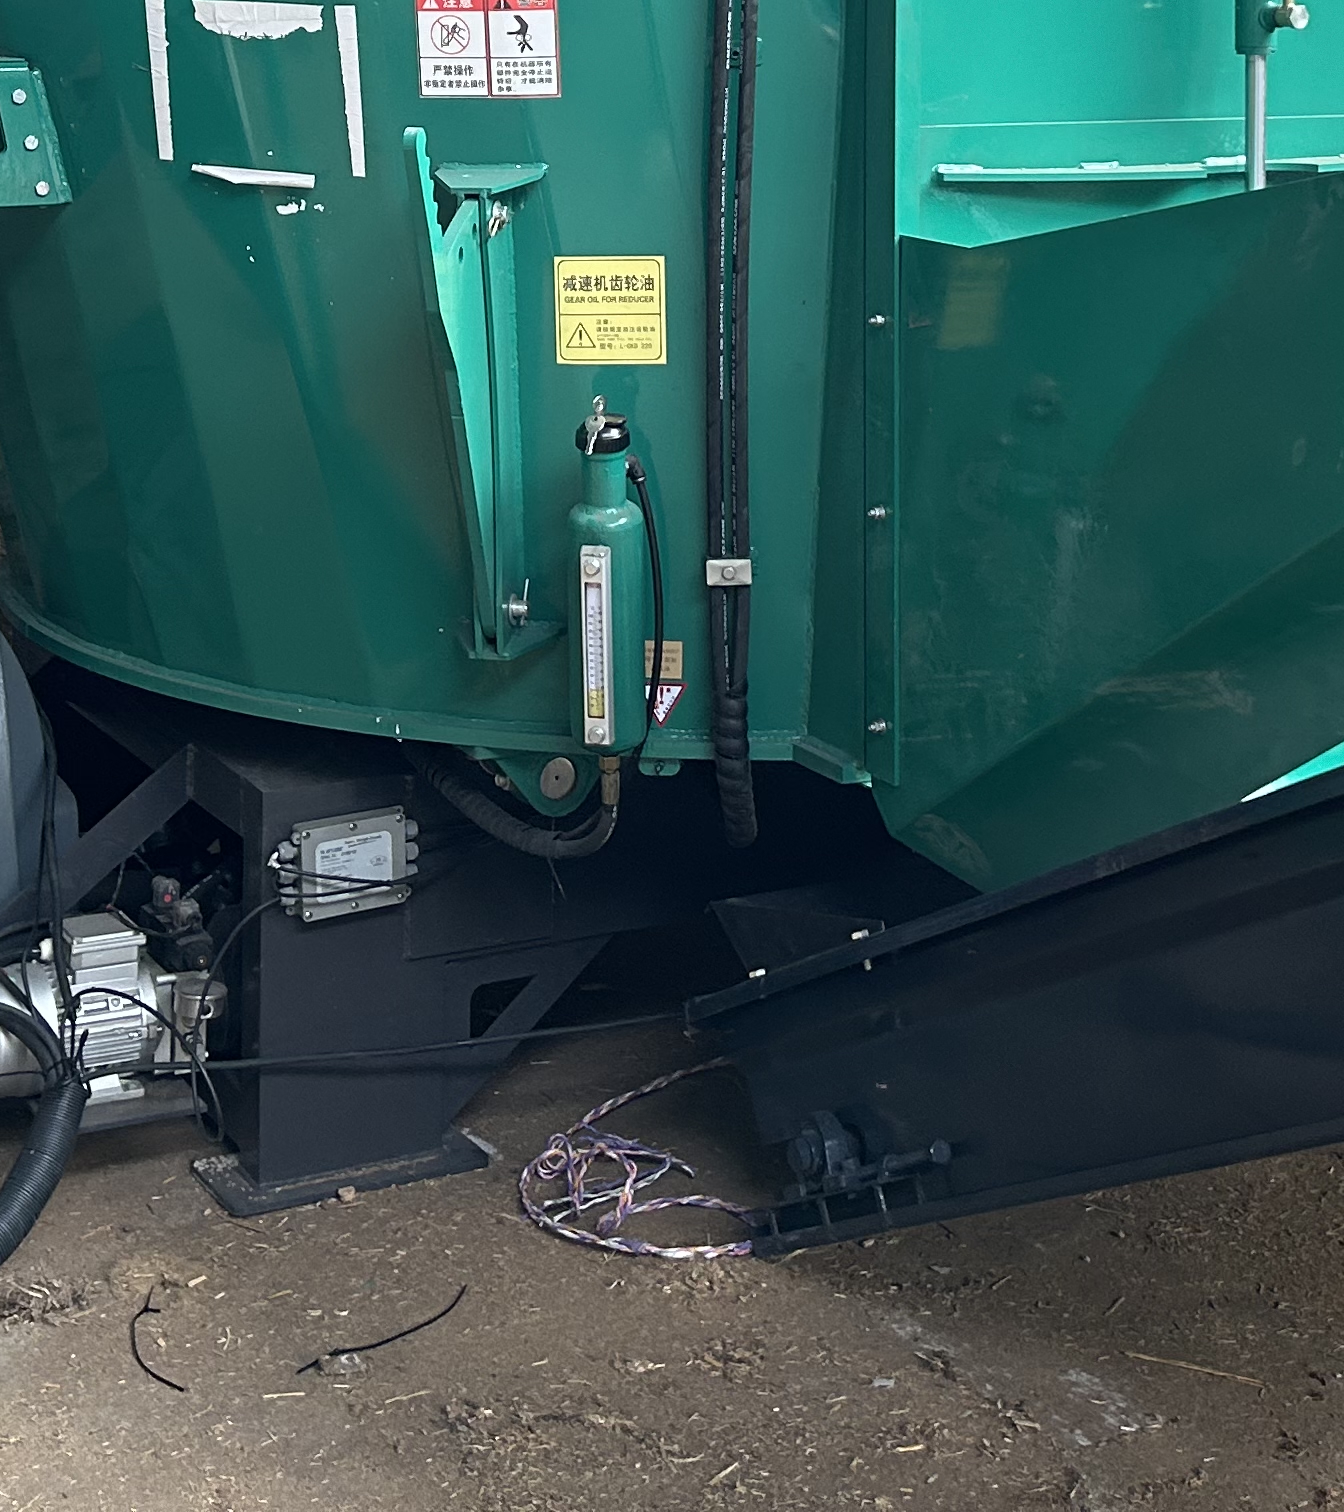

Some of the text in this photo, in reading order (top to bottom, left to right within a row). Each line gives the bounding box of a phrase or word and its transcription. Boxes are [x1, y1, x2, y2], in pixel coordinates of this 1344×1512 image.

[432, 64, 474, 77] 严禁操作
[562, 274, 655, 292] 减速机齿轮油
[564, 296, 586, 304] GEAR
[587, 296, 600, 304] OIL
[618, 295, 655, 303] REDUCER
